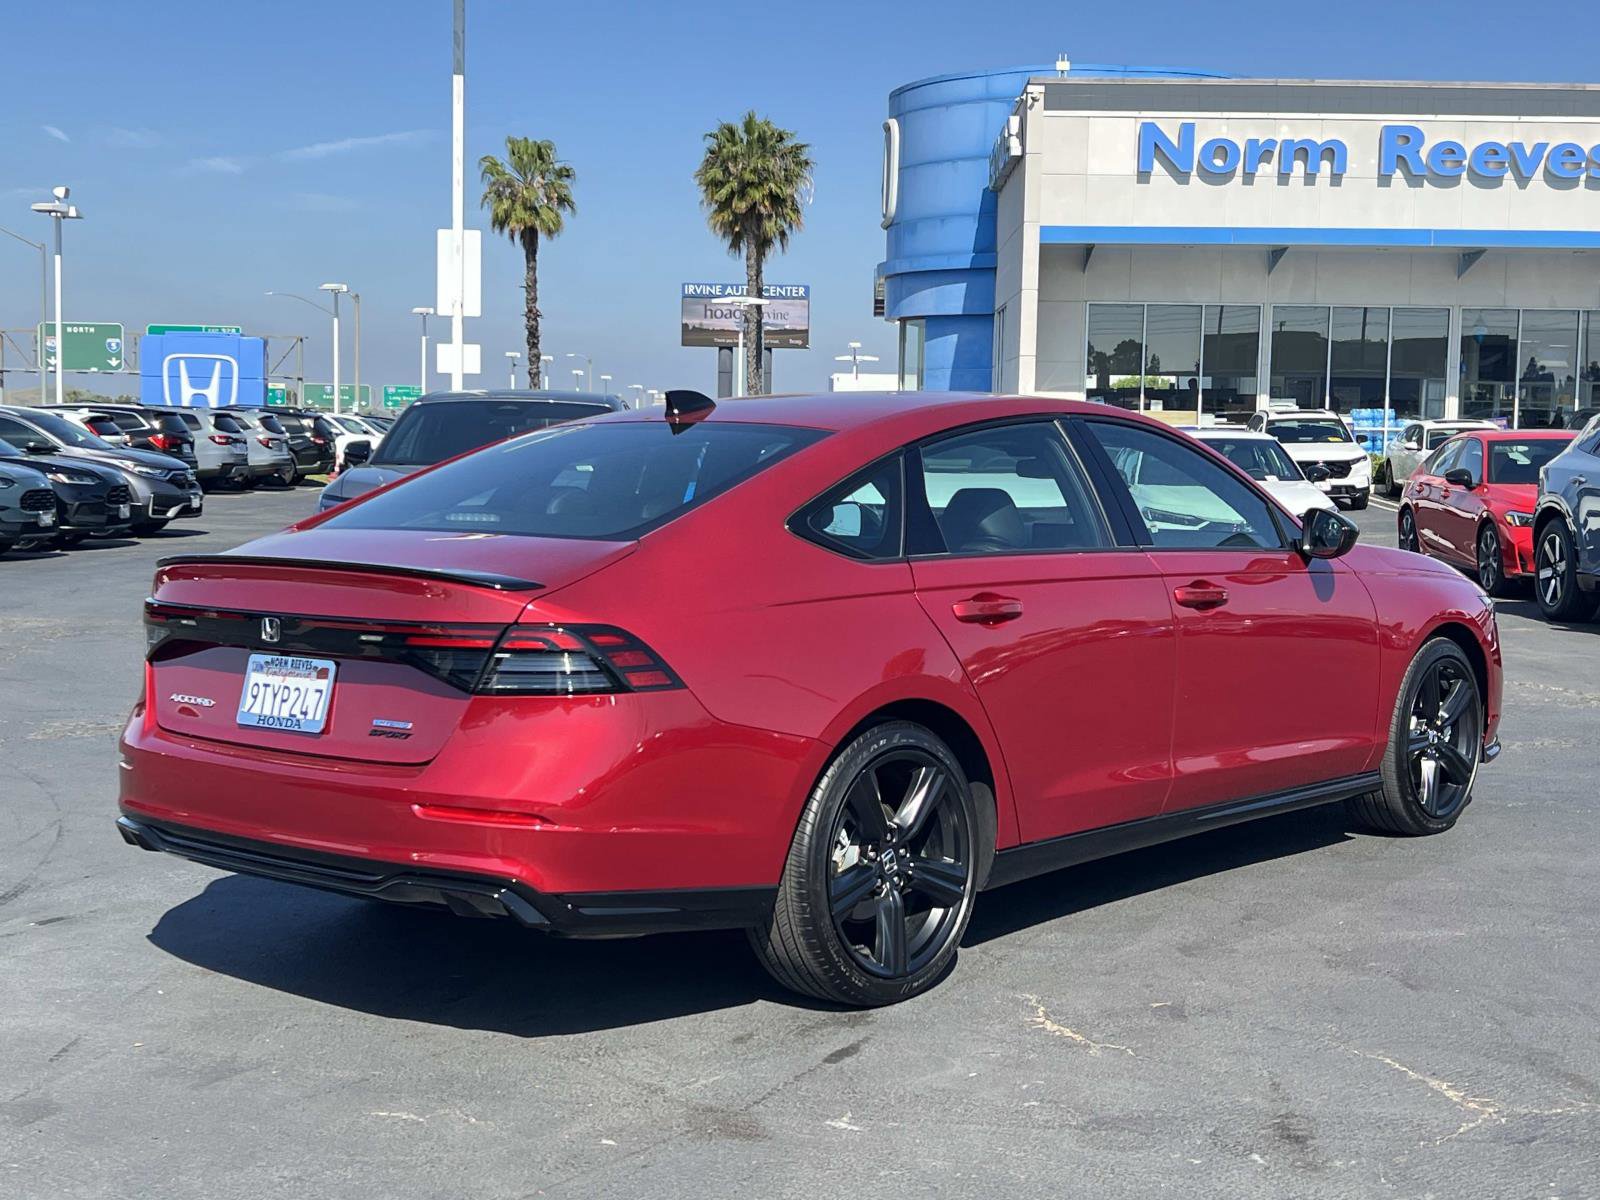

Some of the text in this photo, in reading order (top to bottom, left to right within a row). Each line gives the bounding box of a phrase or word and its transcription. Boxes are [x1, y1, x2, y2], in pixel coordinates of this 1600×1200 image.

[1137, 122, 1348, 176] Norm
[685, 285, 805, 296] IRVINE AUT CENTER
[762, 309, 789, 320] rvine
[270, 657, 314, 671] NORM REEVES
[169, 693, 217, 707] ACCORD
[247, 683, 323, 720] 9TYP247
[256, 714, 302, 730] HONDA
